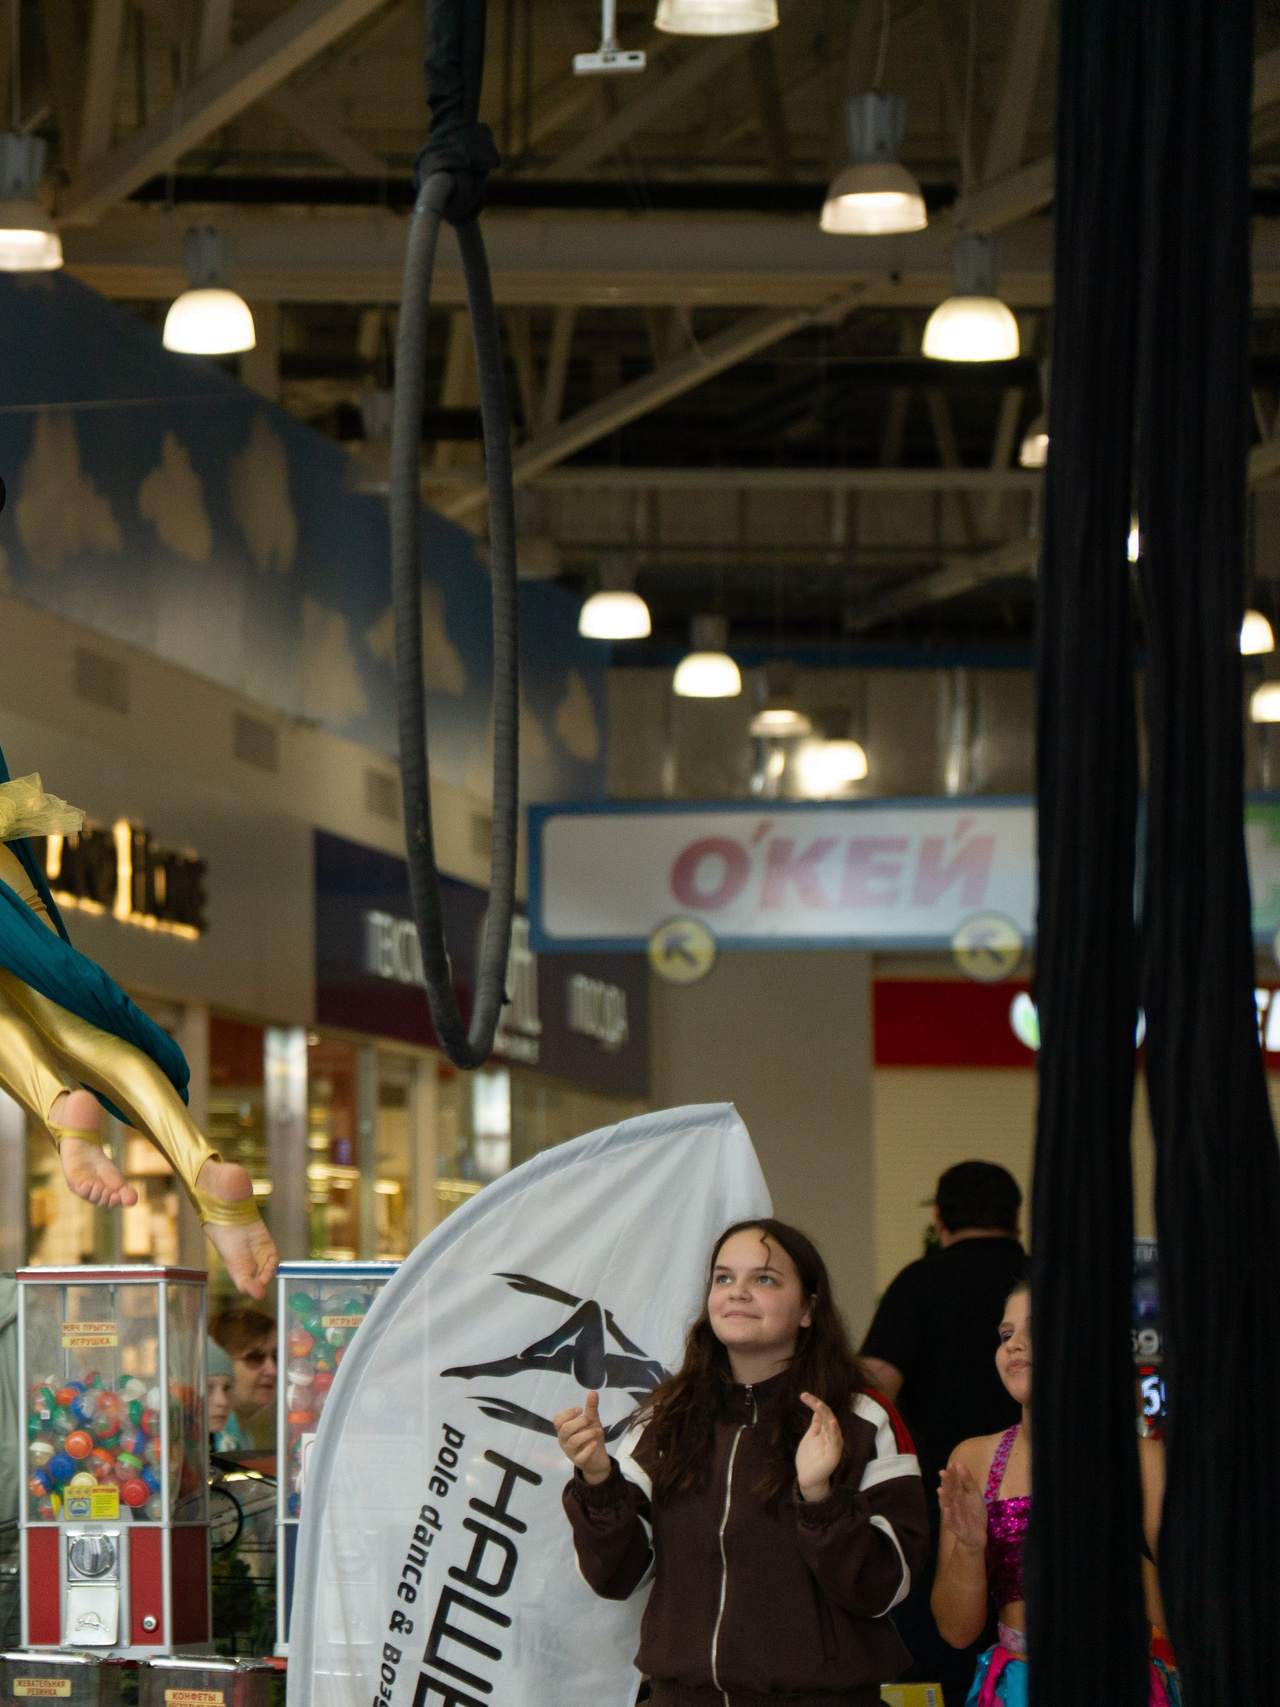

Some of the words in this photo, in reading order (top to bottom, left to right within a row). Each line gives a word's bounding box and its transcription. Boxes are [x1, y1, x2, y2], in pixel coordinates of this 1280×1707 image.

[62, 1323, 80, 1332] МЯЧ
[83, 1323, 116, 1332] ПРЫГУН
[70, 1337, 111, 1347] ИГРУШКА
[428, 1422, 466, 1498] pole
[396, 1504, 443, 1605] dance
[388, 1609, 414, 1635] &
[17, 1680, 66, 1688] ЖЕВАТЕЛЬНАЯ
[26, 1687, 58, 1696] РЕЗИНКА
[172, 1691, 216, 1702] КОНФЕТЫ
